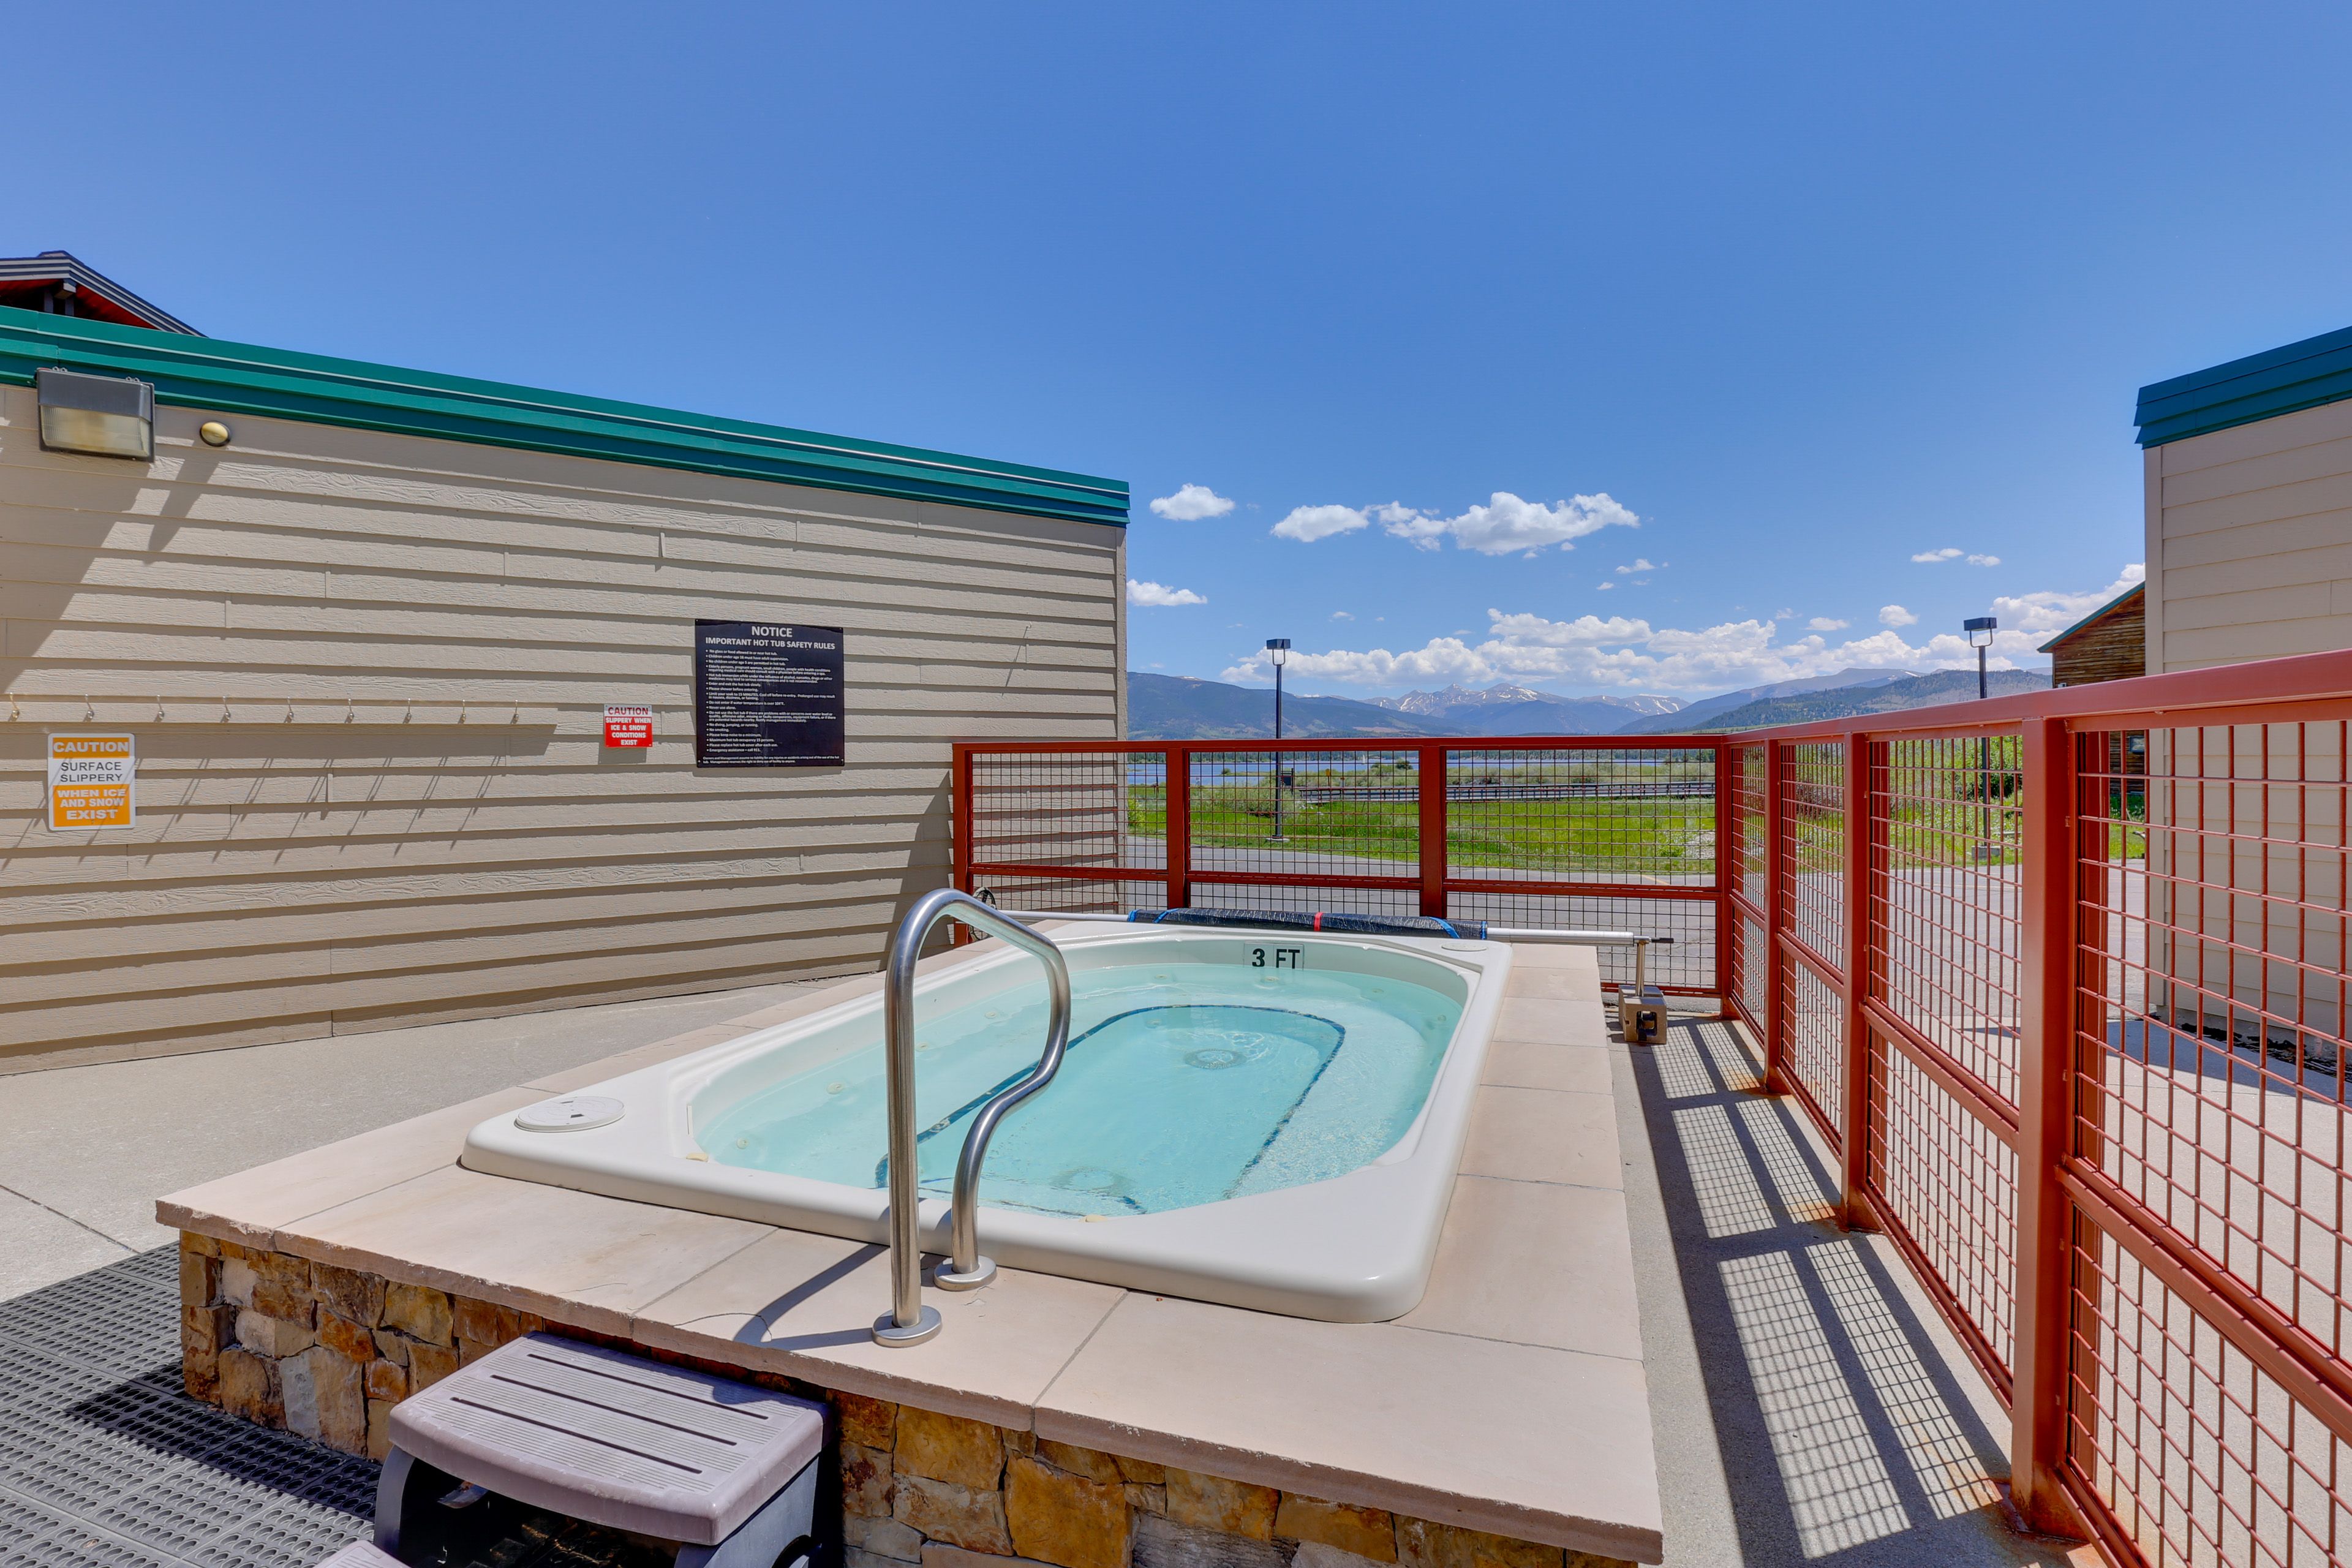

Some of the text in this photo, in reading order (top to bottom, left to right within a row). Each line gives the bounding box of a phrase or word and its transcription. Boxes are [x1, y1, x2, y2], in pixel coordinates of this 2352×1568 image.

[752, 626, 793, 638] NOTICE
[706, 637, 752, 646] IMPORTANT
[53, 742, 129, 753] CAUTION
[61, 761, 122, 771] SURFACE
[60, 774, 123, 782] SLIPPERY
[57, 790, 100, 798] WHEN
[60, 798, 124, 807] AND SNOW
[67, 809, 118, 820] EXIST
[1252, 948, 1300, 969] 3 FT
